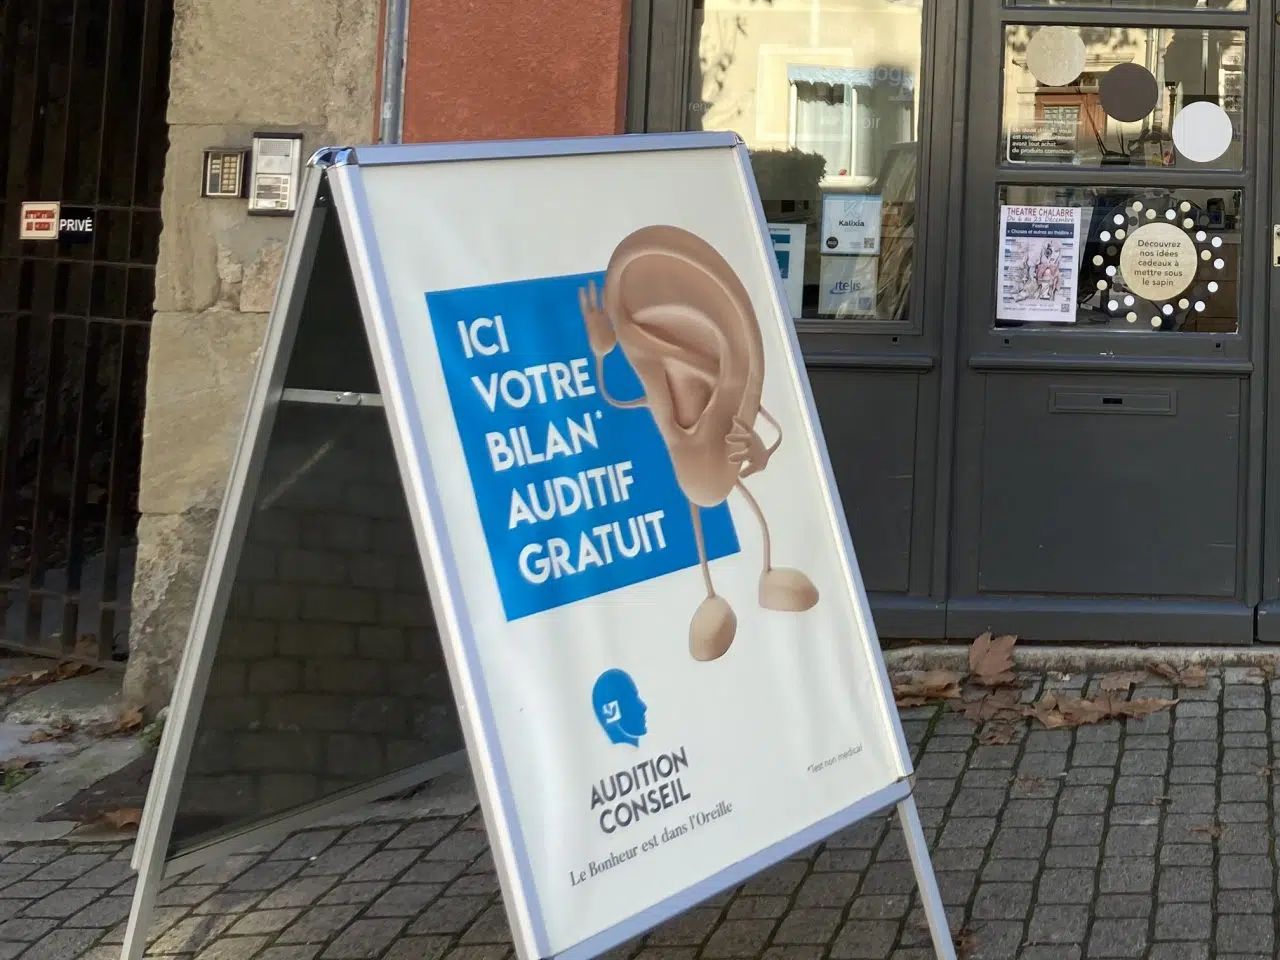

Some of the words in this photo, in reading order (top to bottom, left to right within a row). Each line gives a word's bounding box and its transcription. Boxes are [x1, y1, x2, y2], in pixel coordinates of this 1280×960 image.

[60, 217, 92, 231] PRIVÉ
[1039, 208, 1074, 217] CHALABRE
[1152, 279, 1174, 287] sapin
[457, 315, 510, 359] ICI
[471, 357, 596, 413] VOTRE
[508, 460, 634, 530] AUDITIF
[518, 510, 666, 585] GRATUIT
[590, 746, 689, 810] AUDITION
[600, 777, 691, 834] CONSEIL
[569, 870, 587, 887] Le
[590, 841, 638, 878] Bonheur
[641, 835, 659, 853] est
[661, 822, 688, 843] dans
[689, 801, 733, 830] l'Oreille
